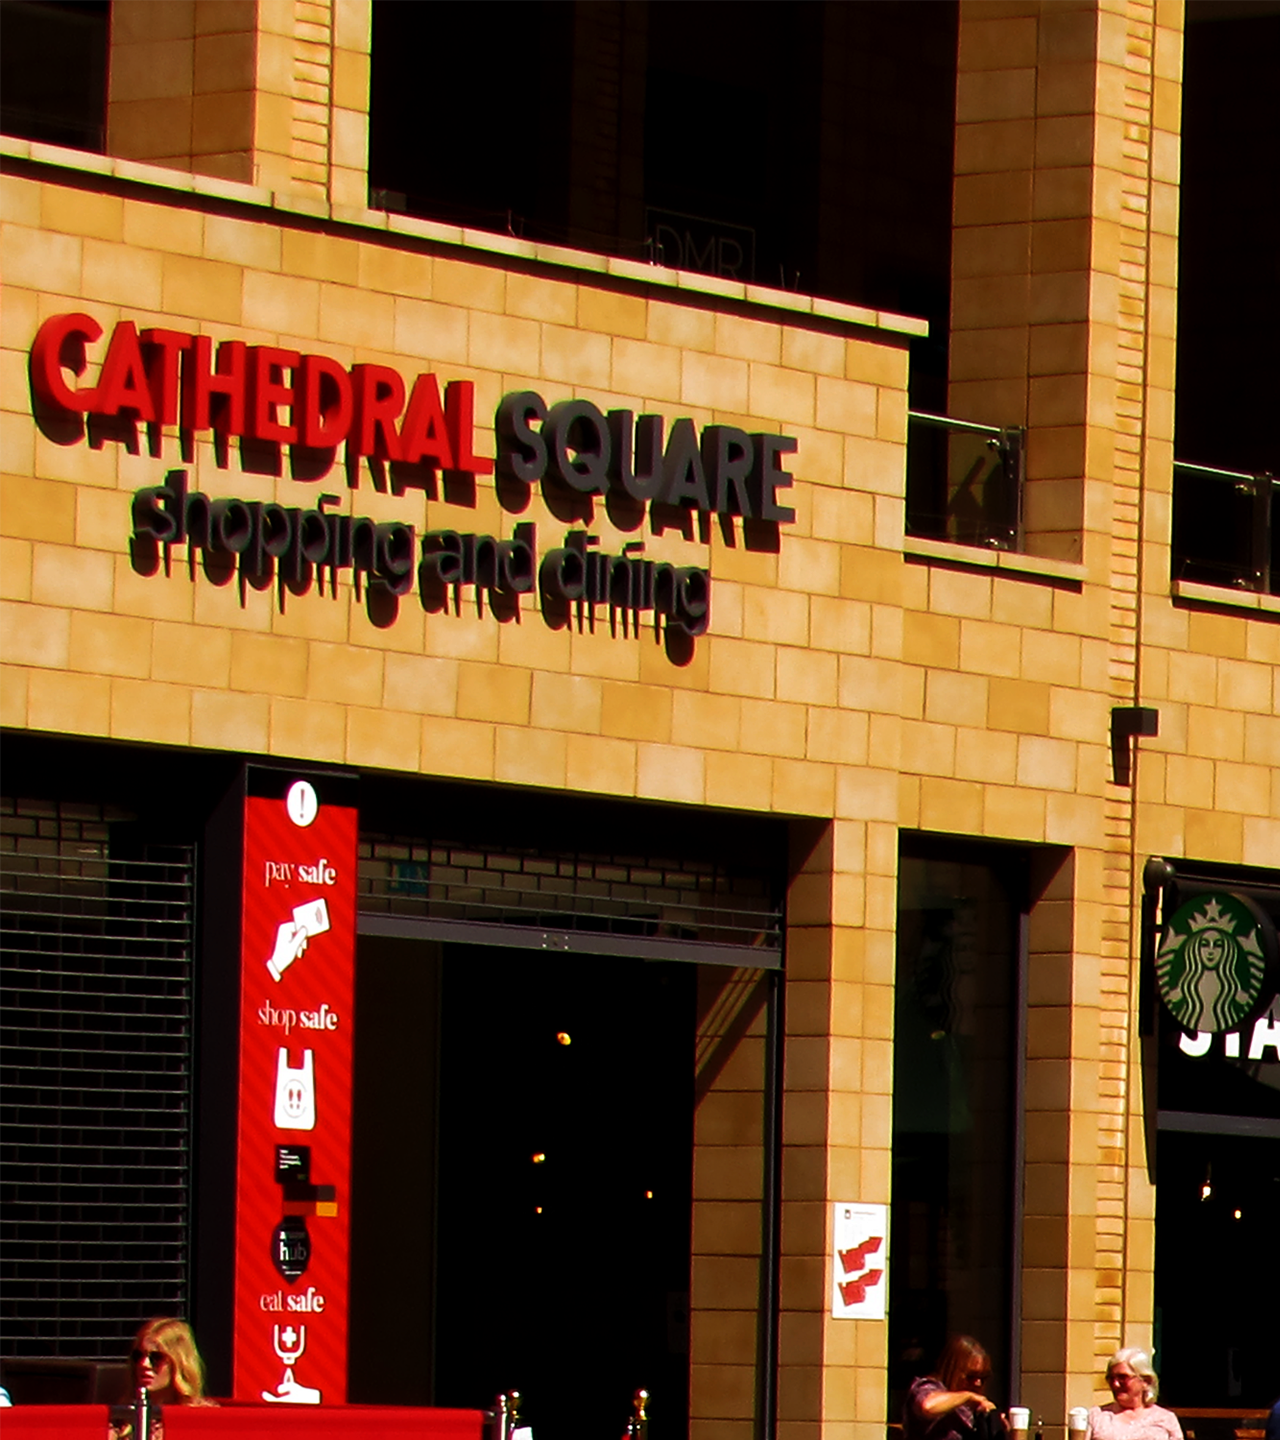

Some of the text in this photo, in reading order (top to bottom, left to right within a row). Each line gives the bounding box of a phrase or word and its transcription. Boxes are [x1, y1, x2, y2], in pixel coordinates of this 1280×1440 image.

[655, 223, 745, 281] DMR
[30, 311, 798, 523] CATHEDRAL SQUARE
[132, 469, 711, 637] shopping and dining
[264, 858, 337, 889] pay safe
[257, 999, 338, 1036] shop safe
[286, 1286, 325, 1313] safe
